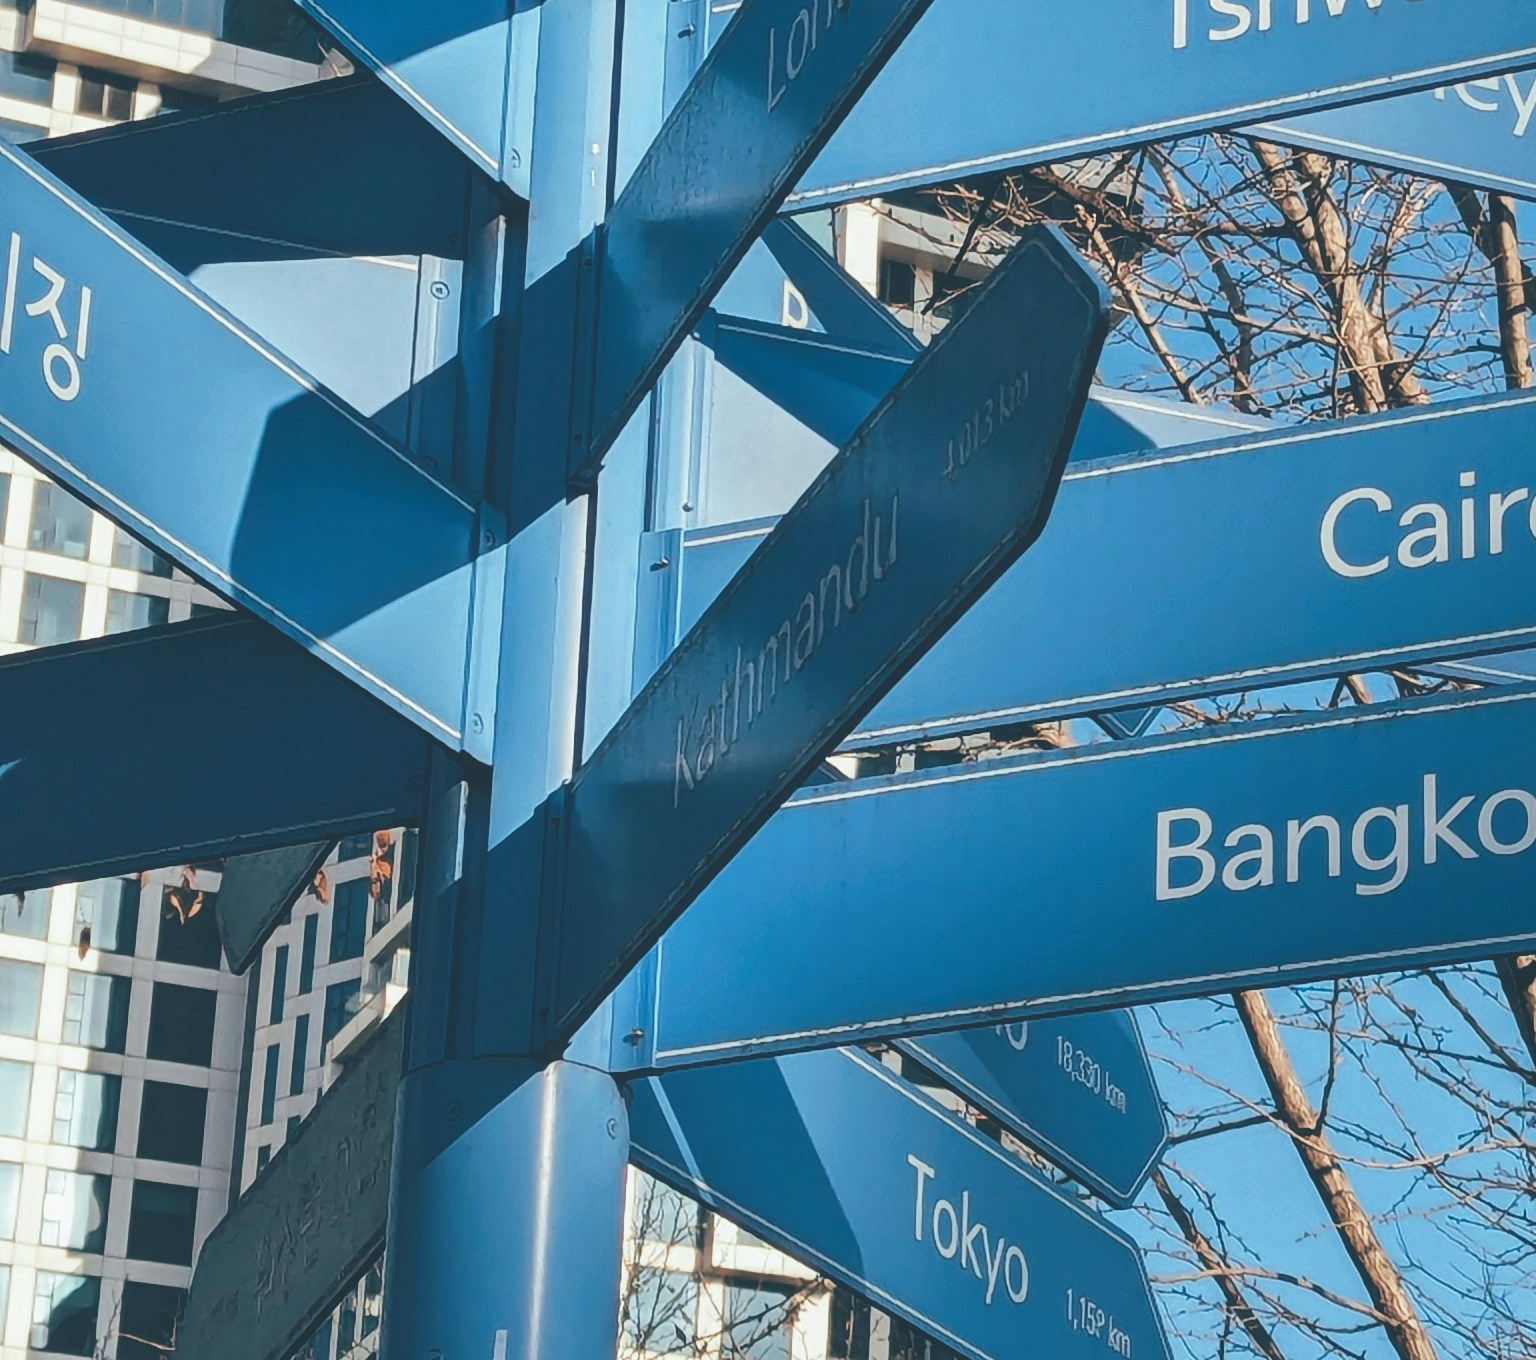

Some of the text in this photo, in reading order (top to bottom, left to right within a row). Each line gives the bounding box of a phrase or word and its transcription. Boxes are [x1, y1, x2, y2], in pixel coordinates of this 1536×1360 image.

[673, 495, 900, 809] Kathmandu
[1105, 1071, 1127, 1115] km
[907, 1154, 1029, 1305] Tokyo
[1107, 1315, 1131, 1359] km
